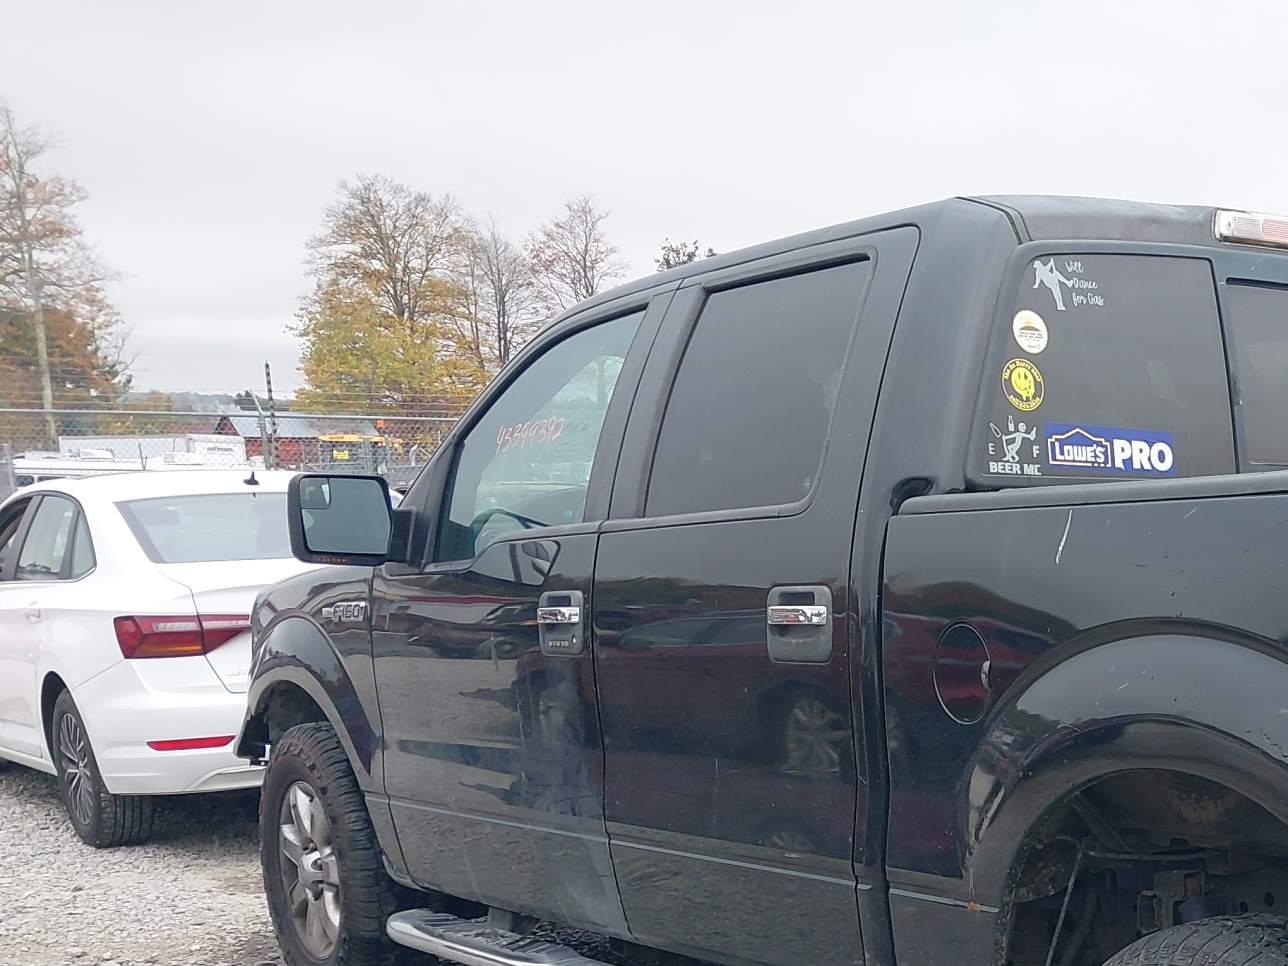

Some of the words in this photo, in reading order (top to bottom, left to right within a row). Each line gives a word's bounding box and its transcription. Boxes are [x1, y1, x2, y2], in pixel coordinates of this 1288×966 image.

[1064, 260, 1084, 273] Will
[1087, 292, 1104, 306] Gas
[496, 416, 566, 455] 43399392
[989, 443, 996, 455] E
[1033, 445, 1040, 458] F
[1055, 441, 1106, 463] LOWE'S
[1113, 439, 1174, 472] PRO
[989, 461, 1021, 475] BEER
